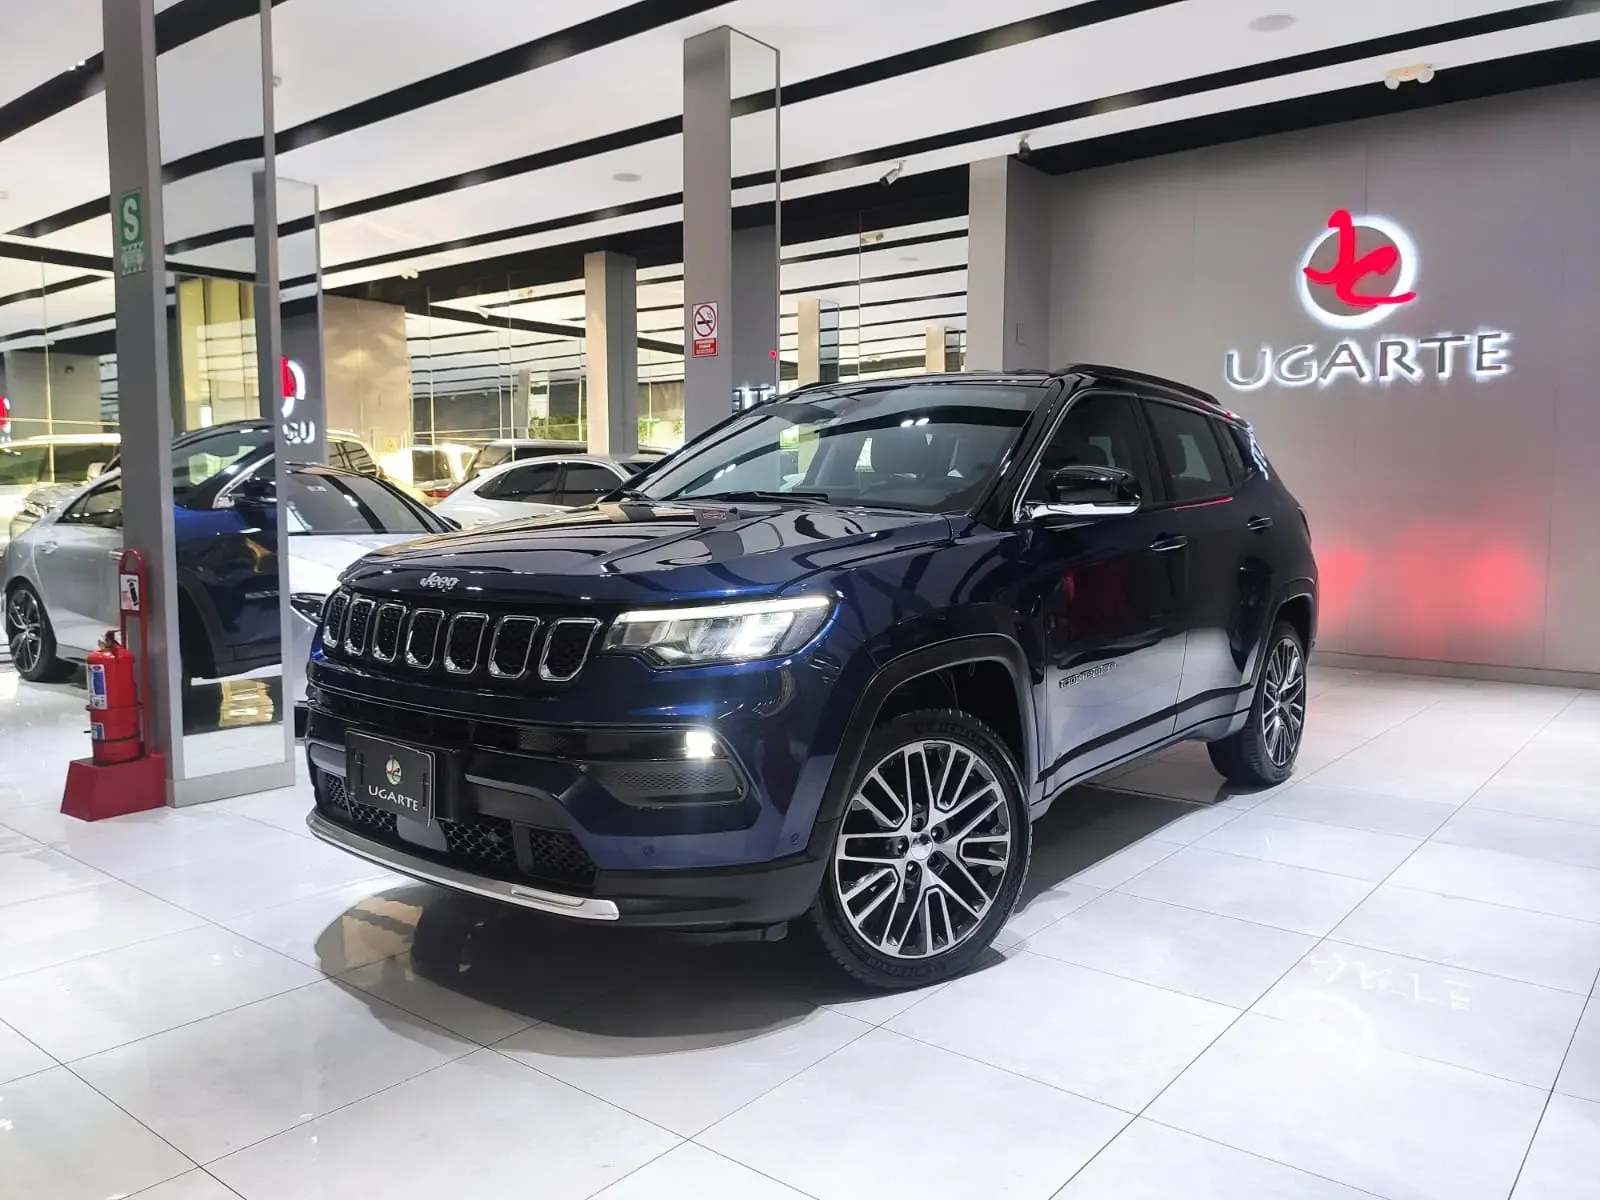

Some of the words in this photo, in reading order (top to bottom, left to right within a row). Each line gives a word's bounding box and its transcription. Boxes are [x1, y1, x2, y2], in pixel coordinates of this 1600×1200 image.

[123, 197, 140, 241] S
[1224, 331, 1511, 390] UGARTE
[419, 571, 461, 591] Jeep
[368, 784, 419, 812] UGARTE
